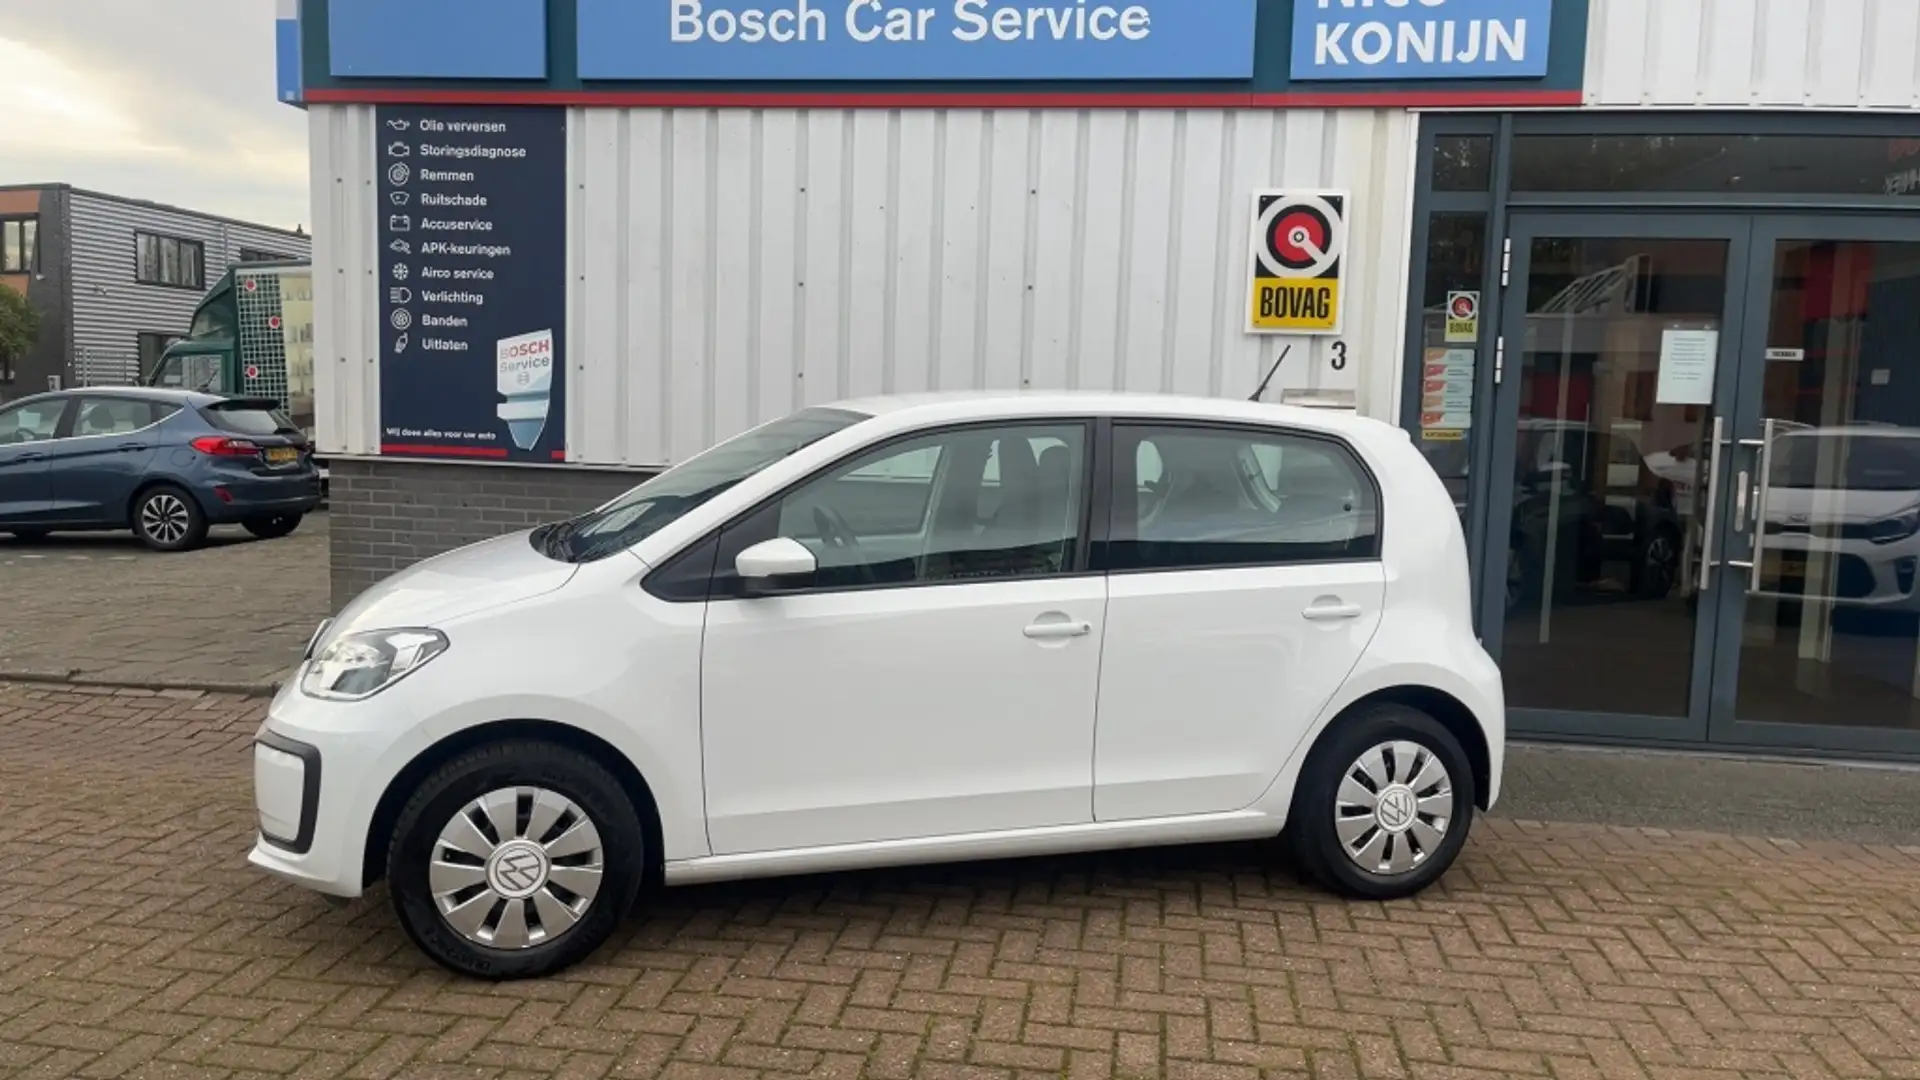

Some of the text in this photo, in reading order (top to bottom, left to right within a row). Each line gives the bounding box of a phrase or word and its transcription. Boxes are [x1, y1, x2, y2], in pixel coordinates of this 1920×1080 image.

[670, 0, 1151, 43] Bosch Car Service
[1314, 18, 1528, 65] KONIJN
[419, 119, 507, 133] Olie verversen
[419, 143, 527, 160] Storingsdiagnose
[419, 168, 475, 182] Remmen
[420, 192, 488, 206] Ruitschade
[420, 217, 493, 231] Accuservice
[420, 241, 512, 258] APK-keuringen
[421, 266, 494, 280] Airco service
[421, 290, 484, 305] Verlichting
[1259, 286, 1331, 319] BOVAG
[421, 314, 468, 327] Banden
[421, 338, 468, 351] Uitlaten
[500, 339, 549, 360] BOSCH
[1331, 340, 1347, 370] 3
[500, 356, 550, 373] Service
[401, 428, 422, 437] doen
